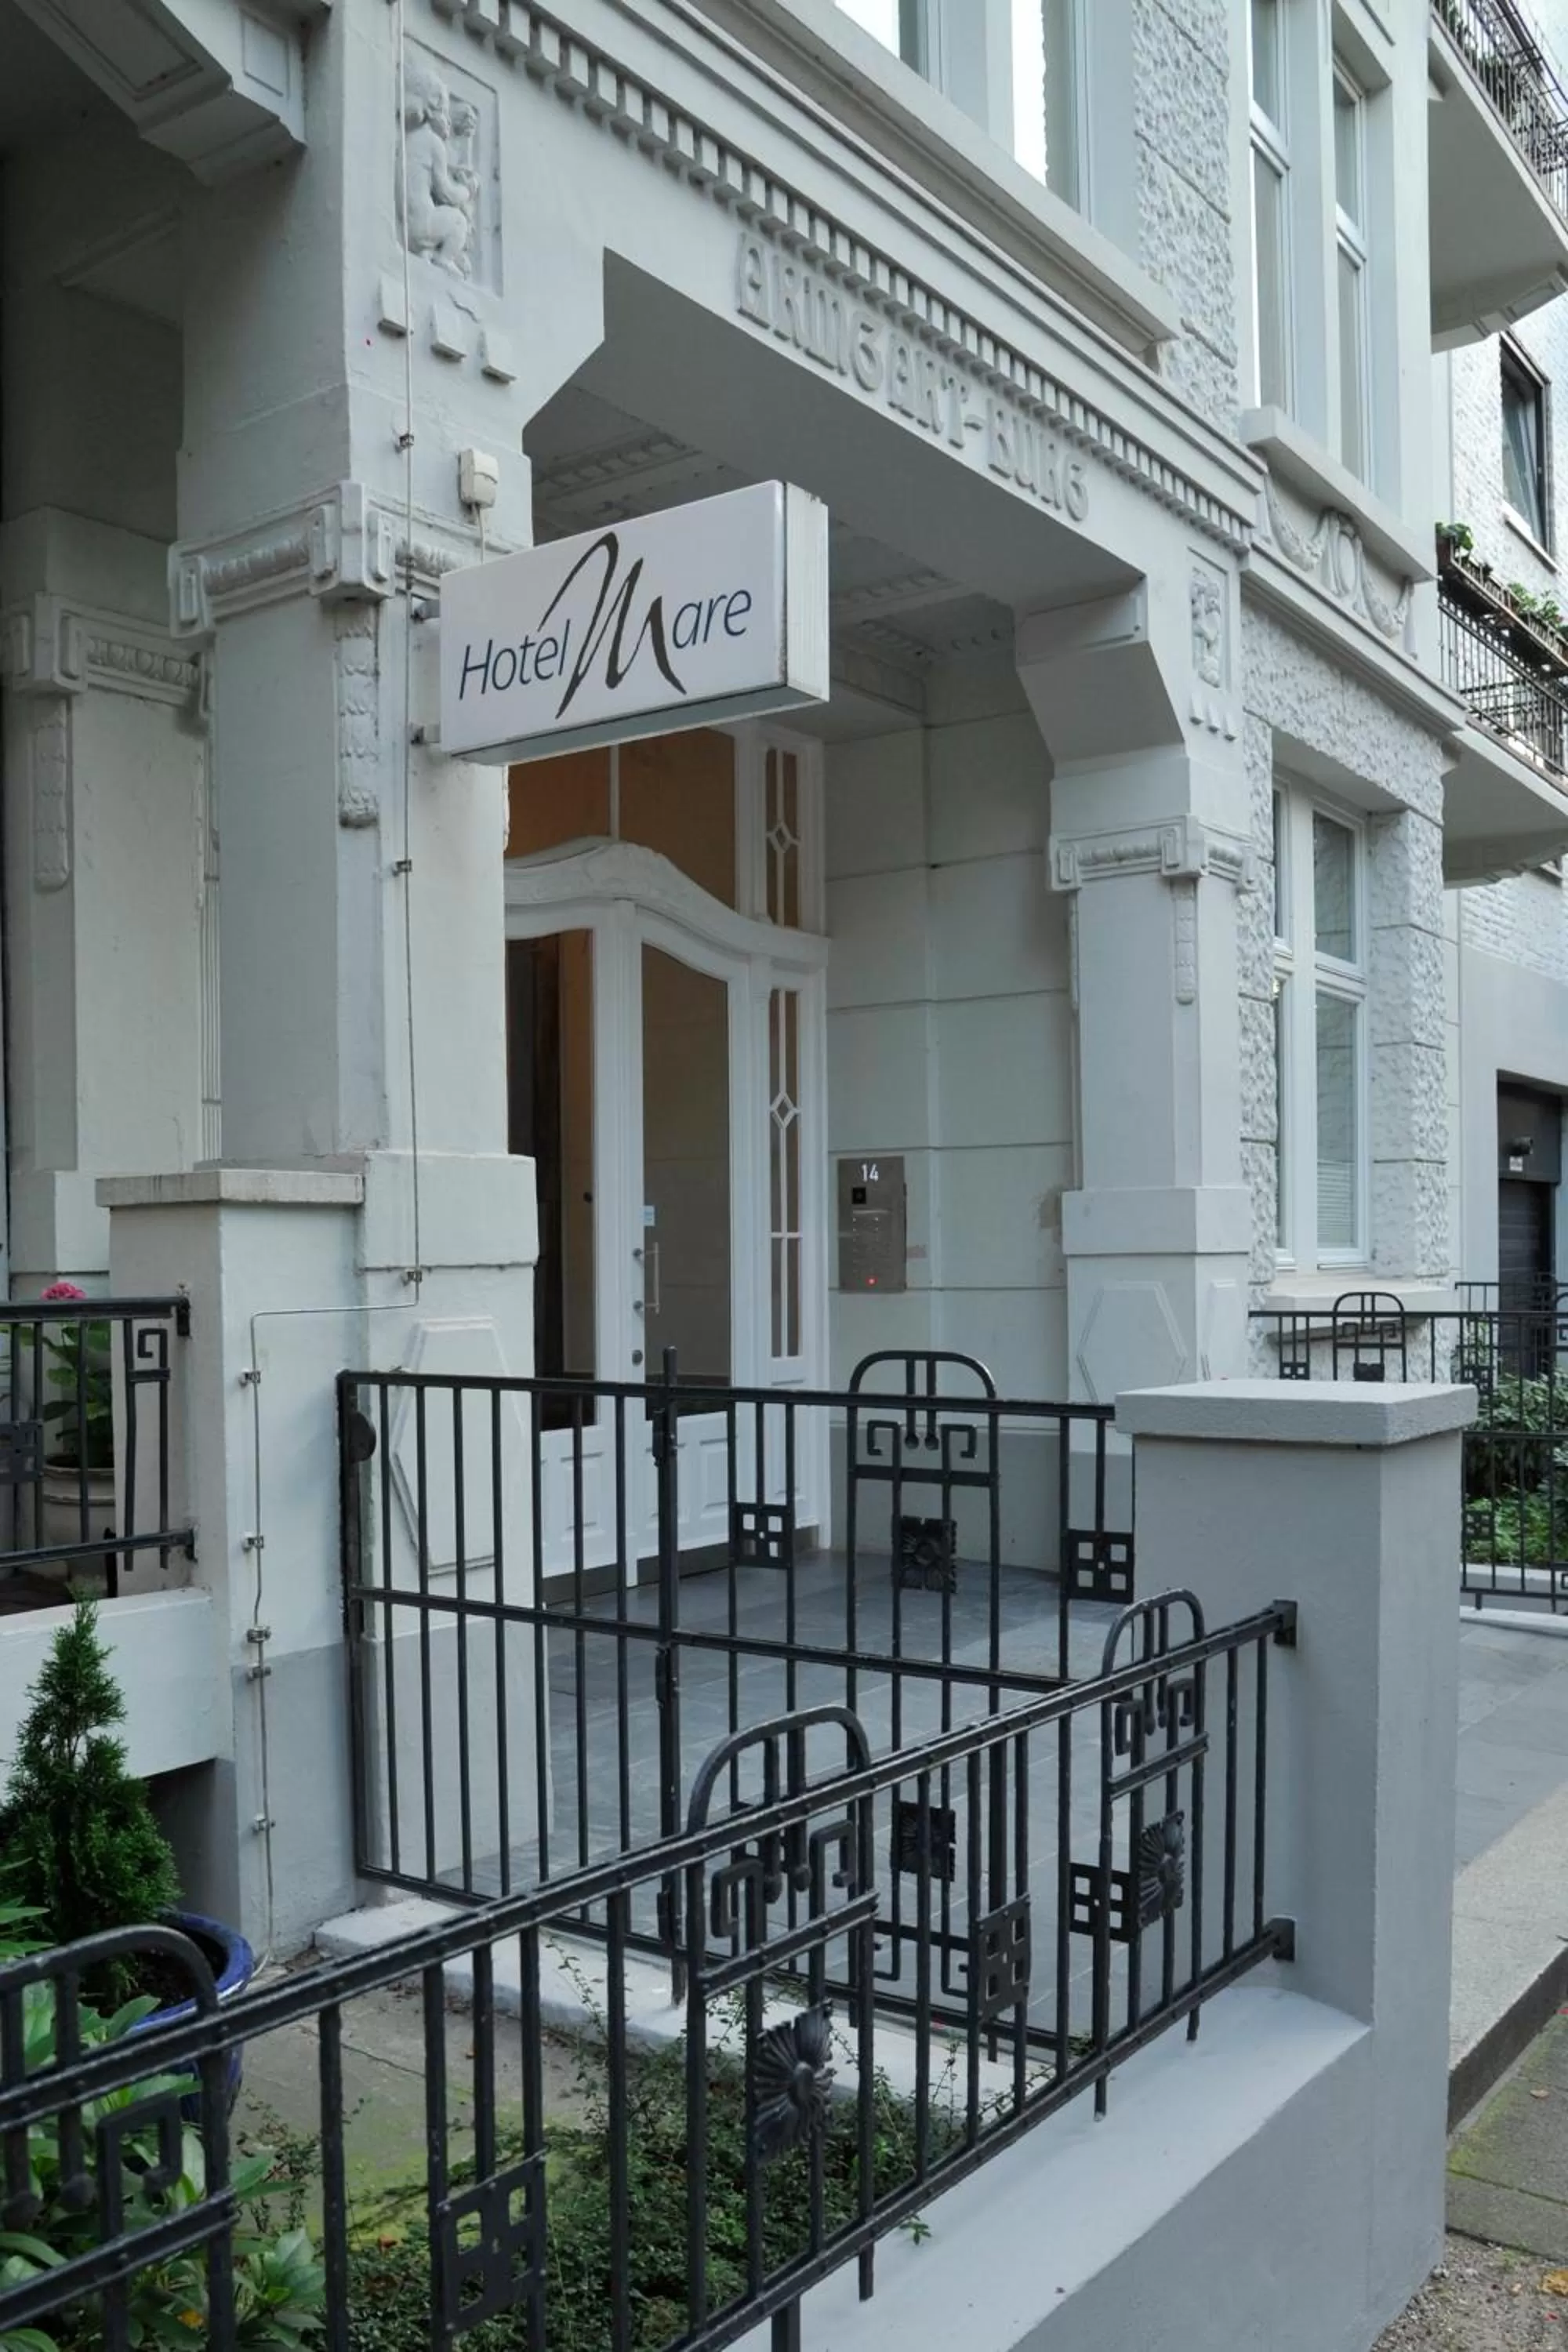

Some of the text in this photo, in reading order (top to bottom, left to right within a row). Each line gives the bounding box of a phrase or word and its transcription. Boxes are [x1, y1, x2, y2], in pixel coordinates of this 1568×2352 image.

[458, 531, 753, 720] Hotel Mare
[862, 1163, 880, 1182] 14
